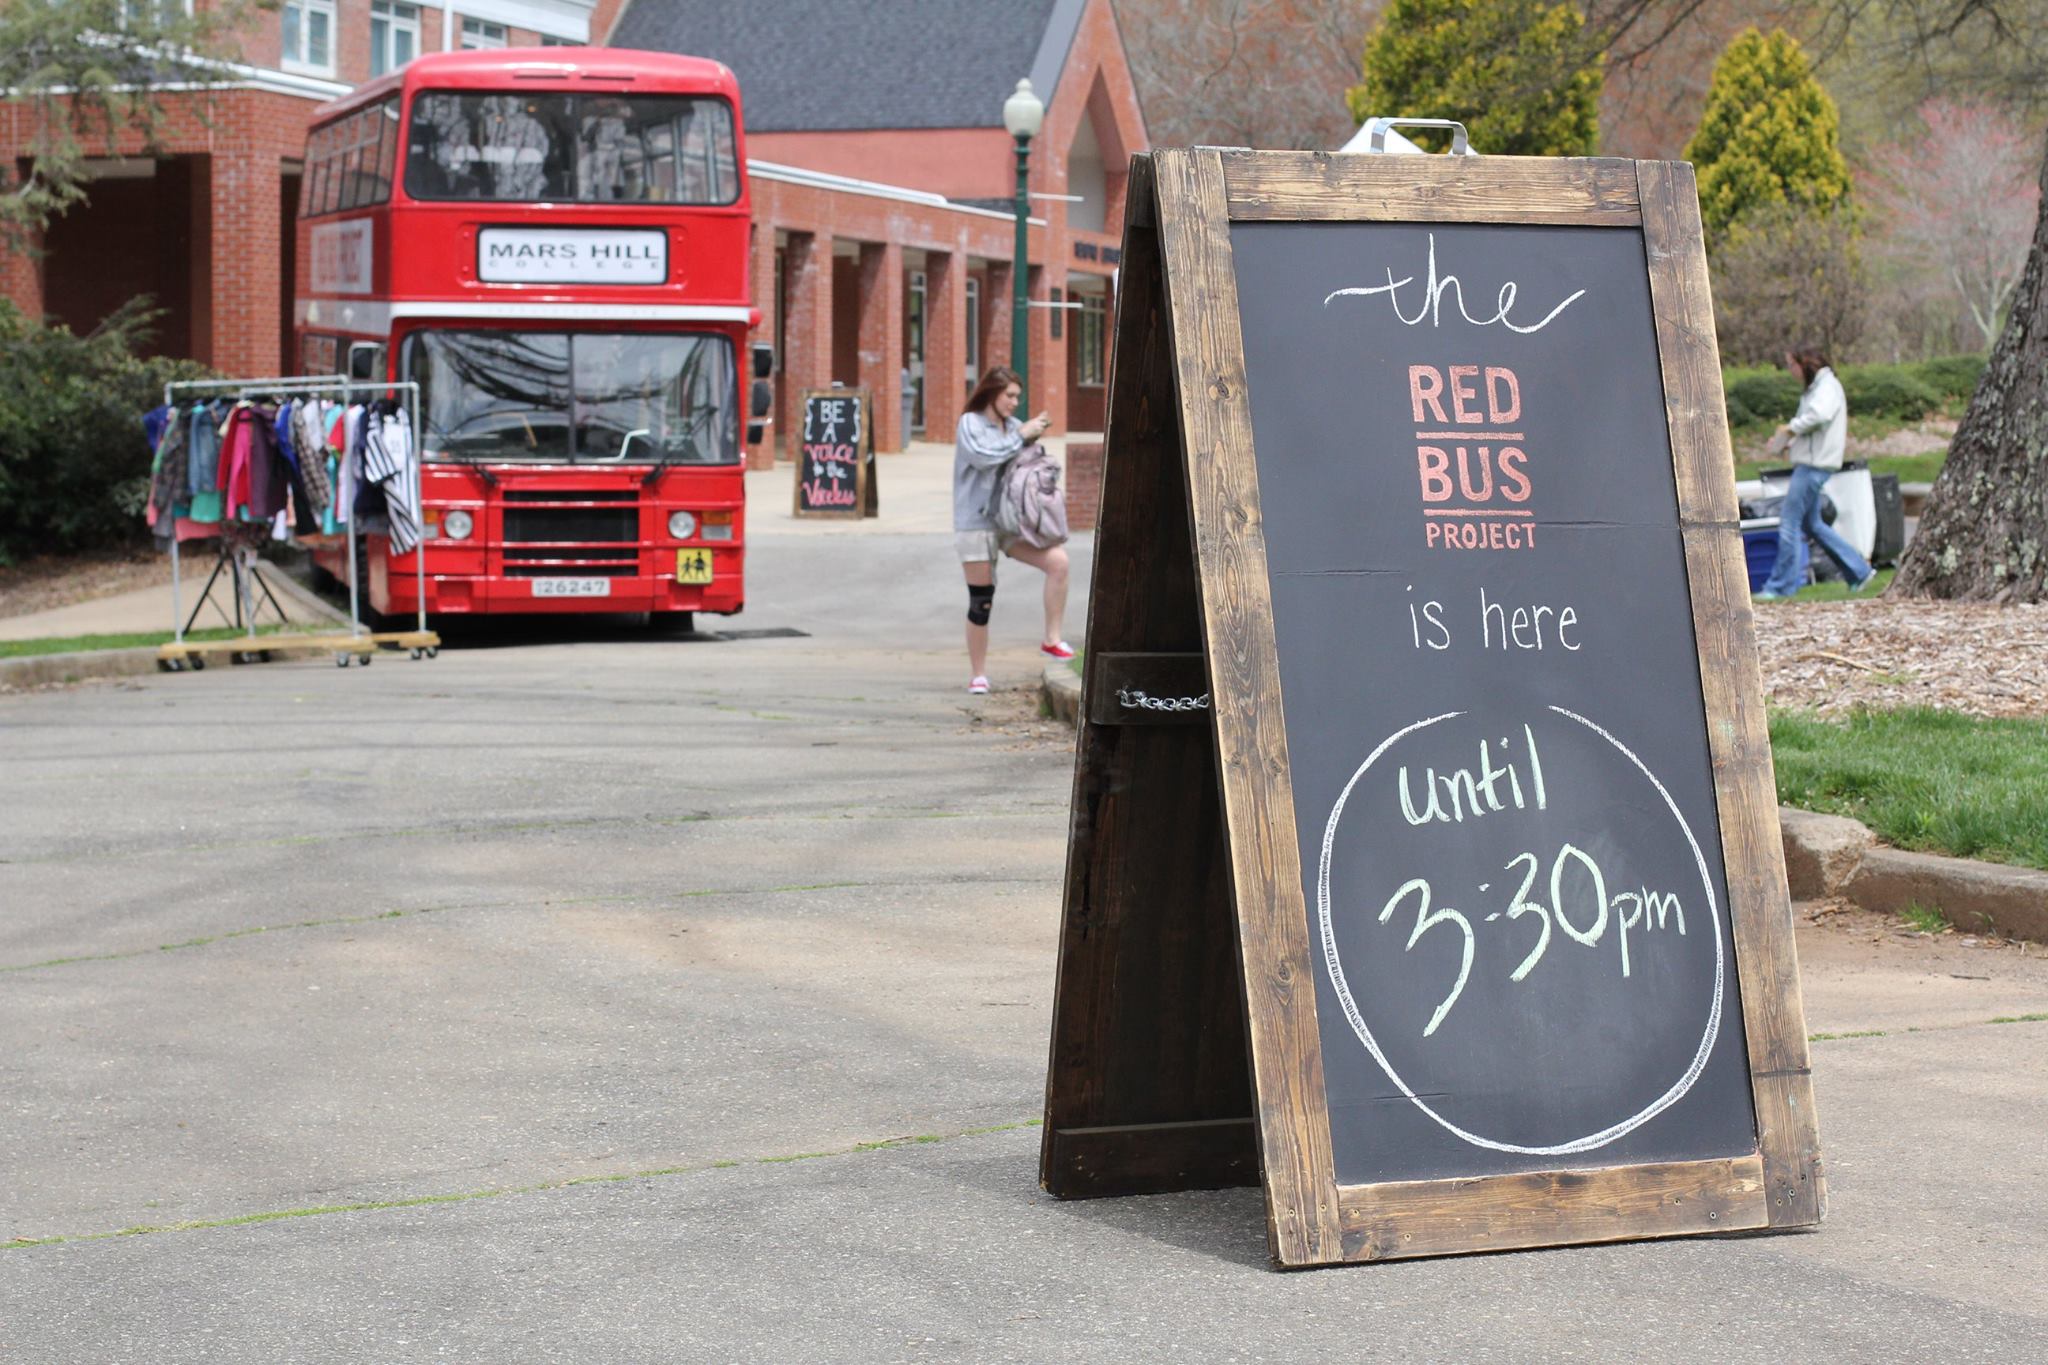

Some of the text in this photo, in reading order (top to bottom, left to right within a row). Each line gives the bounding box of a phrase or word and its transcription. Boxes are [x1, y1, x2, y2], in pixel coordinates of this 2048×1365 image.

[488, 260, 659, 269] COLLEGE
[490, 244, 659, 260] MARS HILL
[1324, 233, 1587, 334] the
[820, 400, 846, 424] BE
[1408, 364, 1522, 425] RED
[822, 423, 837, 442] A
[1417, 445, 1533, 503] BUS
[1425, 522, 1536, 550] PROJECT
[1406, 585, 1582, 651] is here
[1398, 723, 1547, 826] until
